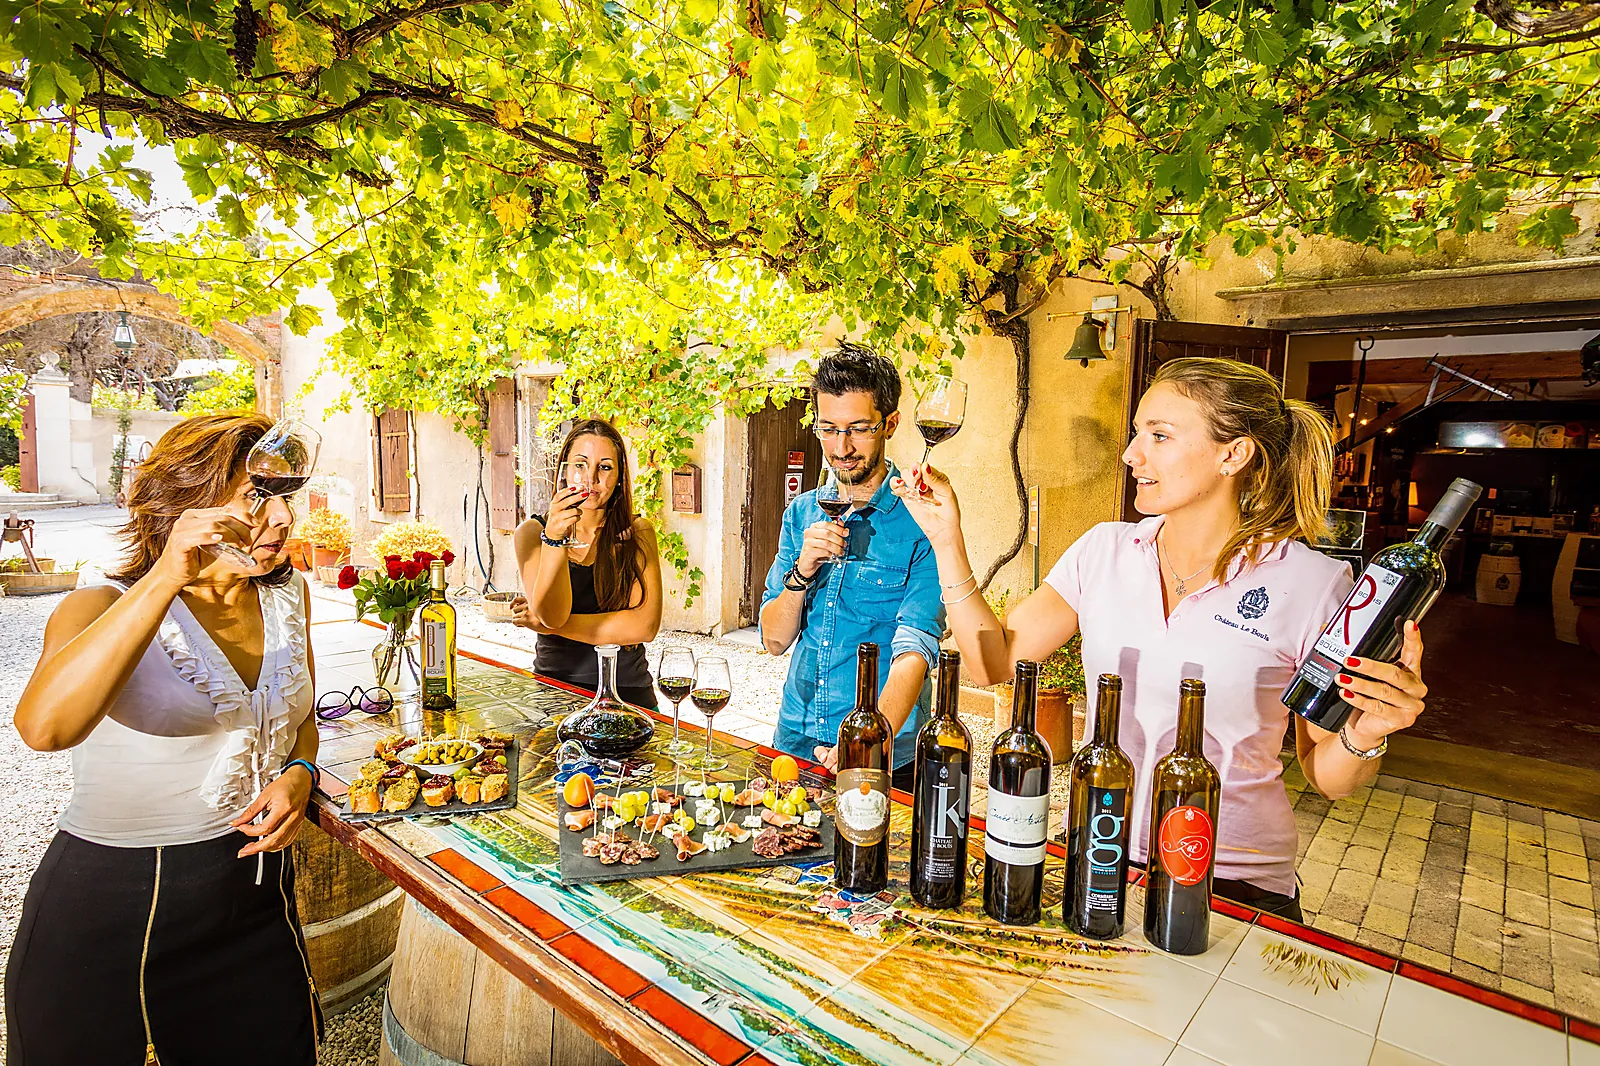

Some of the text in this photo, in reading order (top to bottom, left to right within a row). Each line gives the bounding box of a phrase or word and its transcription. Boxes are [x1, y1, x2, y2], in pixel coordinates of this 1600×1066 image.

[1240, 624, 1251, 632] Le
[1326, 573, 1377, 646] R
[932, 783, 968, 839] K
[1086, 814, 1125, 867] g
